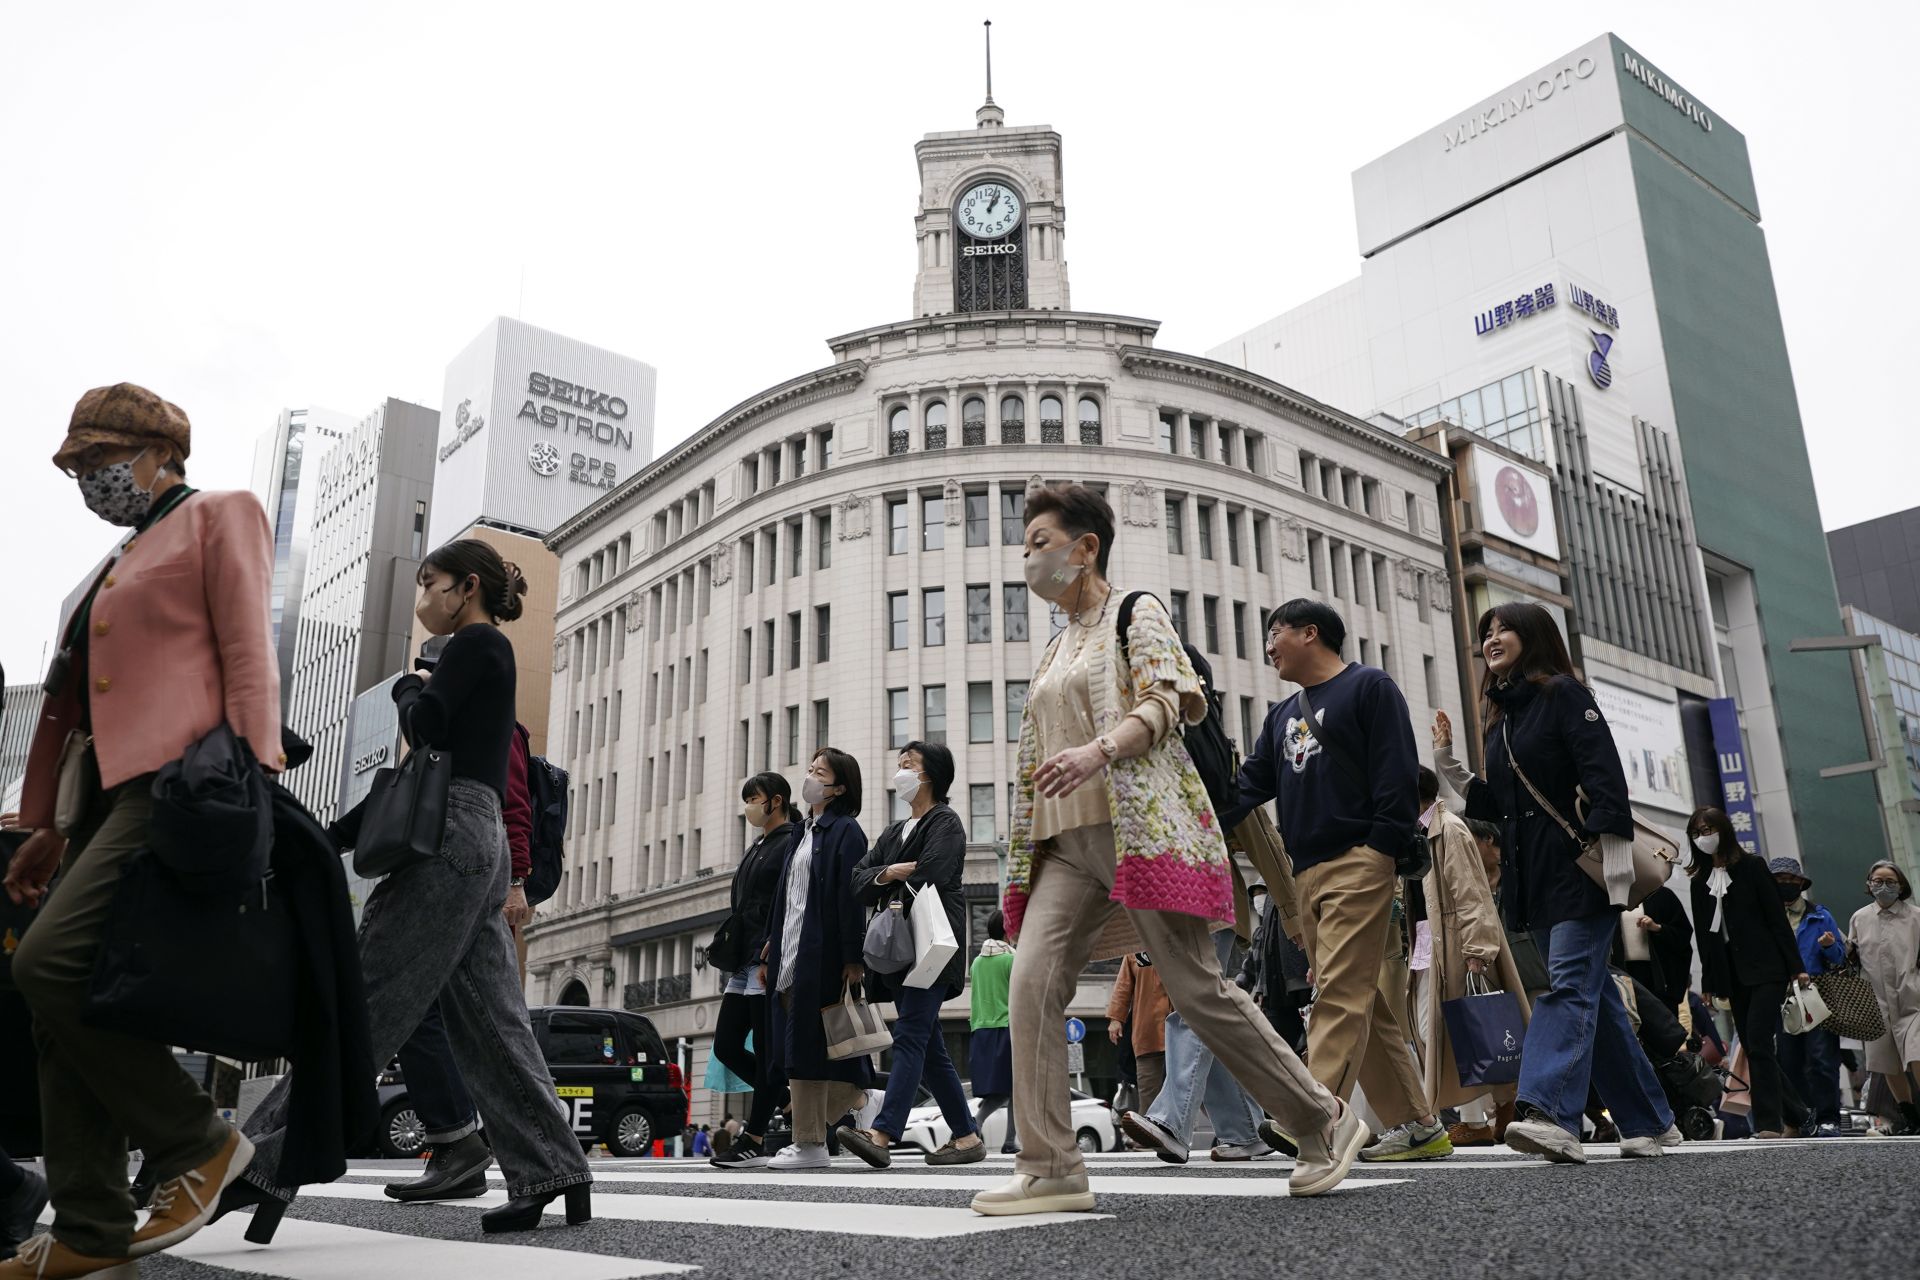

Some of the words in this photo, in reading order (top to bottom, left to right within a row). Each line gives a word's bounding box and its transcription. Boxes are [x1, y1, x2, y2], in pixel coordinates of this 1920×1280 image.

[1622, 52, 1712, 132] MIKIMOTO
[1444, 57, 1596, 152] MIKIMOTO
[975, 190, 983, 200] 11
[984, 187, 994, 197] 12
[967, 198, 976, 207] 10
[1003, 195, 1011, 204] 2
[963, 207, 972, 217] 9
[1007, 204, 1015, 214] 3
[967, 216, 975, 226] 8
[1003, 214, 1012, 223] 4
[976, 222, 984, 232] 7
[985, 223, 993, 234] 6
[996, 221, 1003, 231] 5
[963, 243, 1017, 256] SEIKO
[1474, 282, 1556, 337] 山野楽器
[1569, 282, 1621, 330] 山野楽器
[528, 371, 628, 421] SEIKO
[517, 399, 633, 451] ASTRON
[570, 452, 617, 479] GPS
[568, 469, 616, 491] SOLAR
[353, 745, 388, 776] SEIKO
